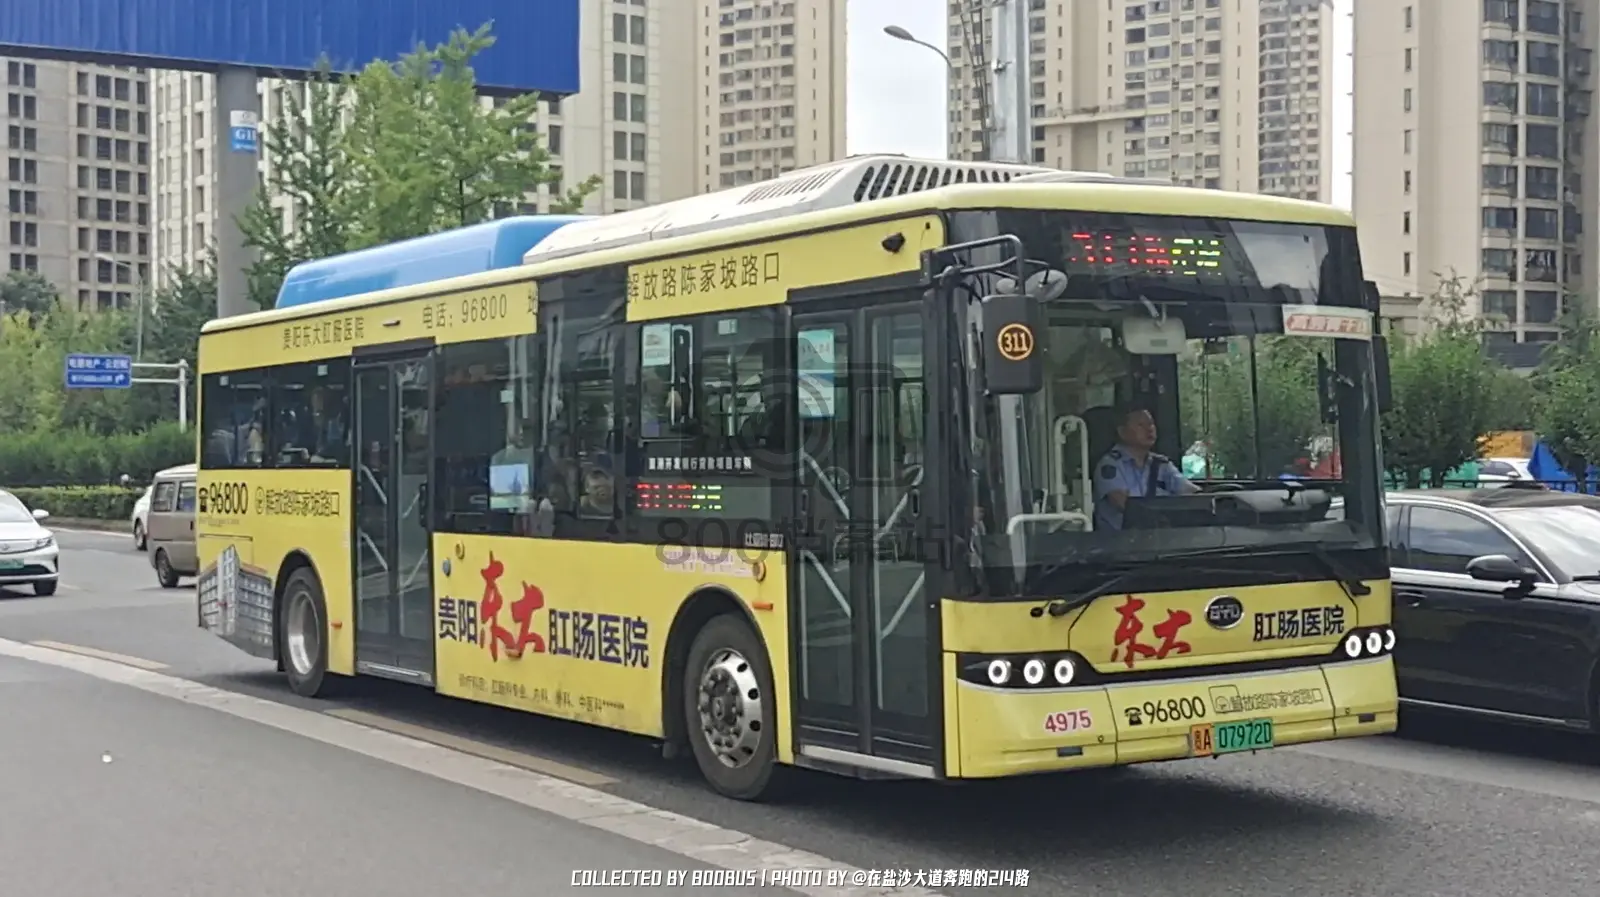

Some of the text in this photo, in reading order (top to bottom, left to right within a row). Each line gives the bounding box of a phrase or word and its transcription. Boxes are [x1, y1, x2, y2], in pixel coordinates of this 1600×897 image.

[282, 316, 365, 351] 贵阳东大肛肠医院
[1004, 332, 1028, 352] 311
[209, 482, 249, 515] 96800
[1209, 604, 1241, 620] BYD
[1111, 594, 1345, 668] 东大 肛肠医院
[1045, 710, 1091, 733] 4975
[1142, 696, 1206, 724] 96800
